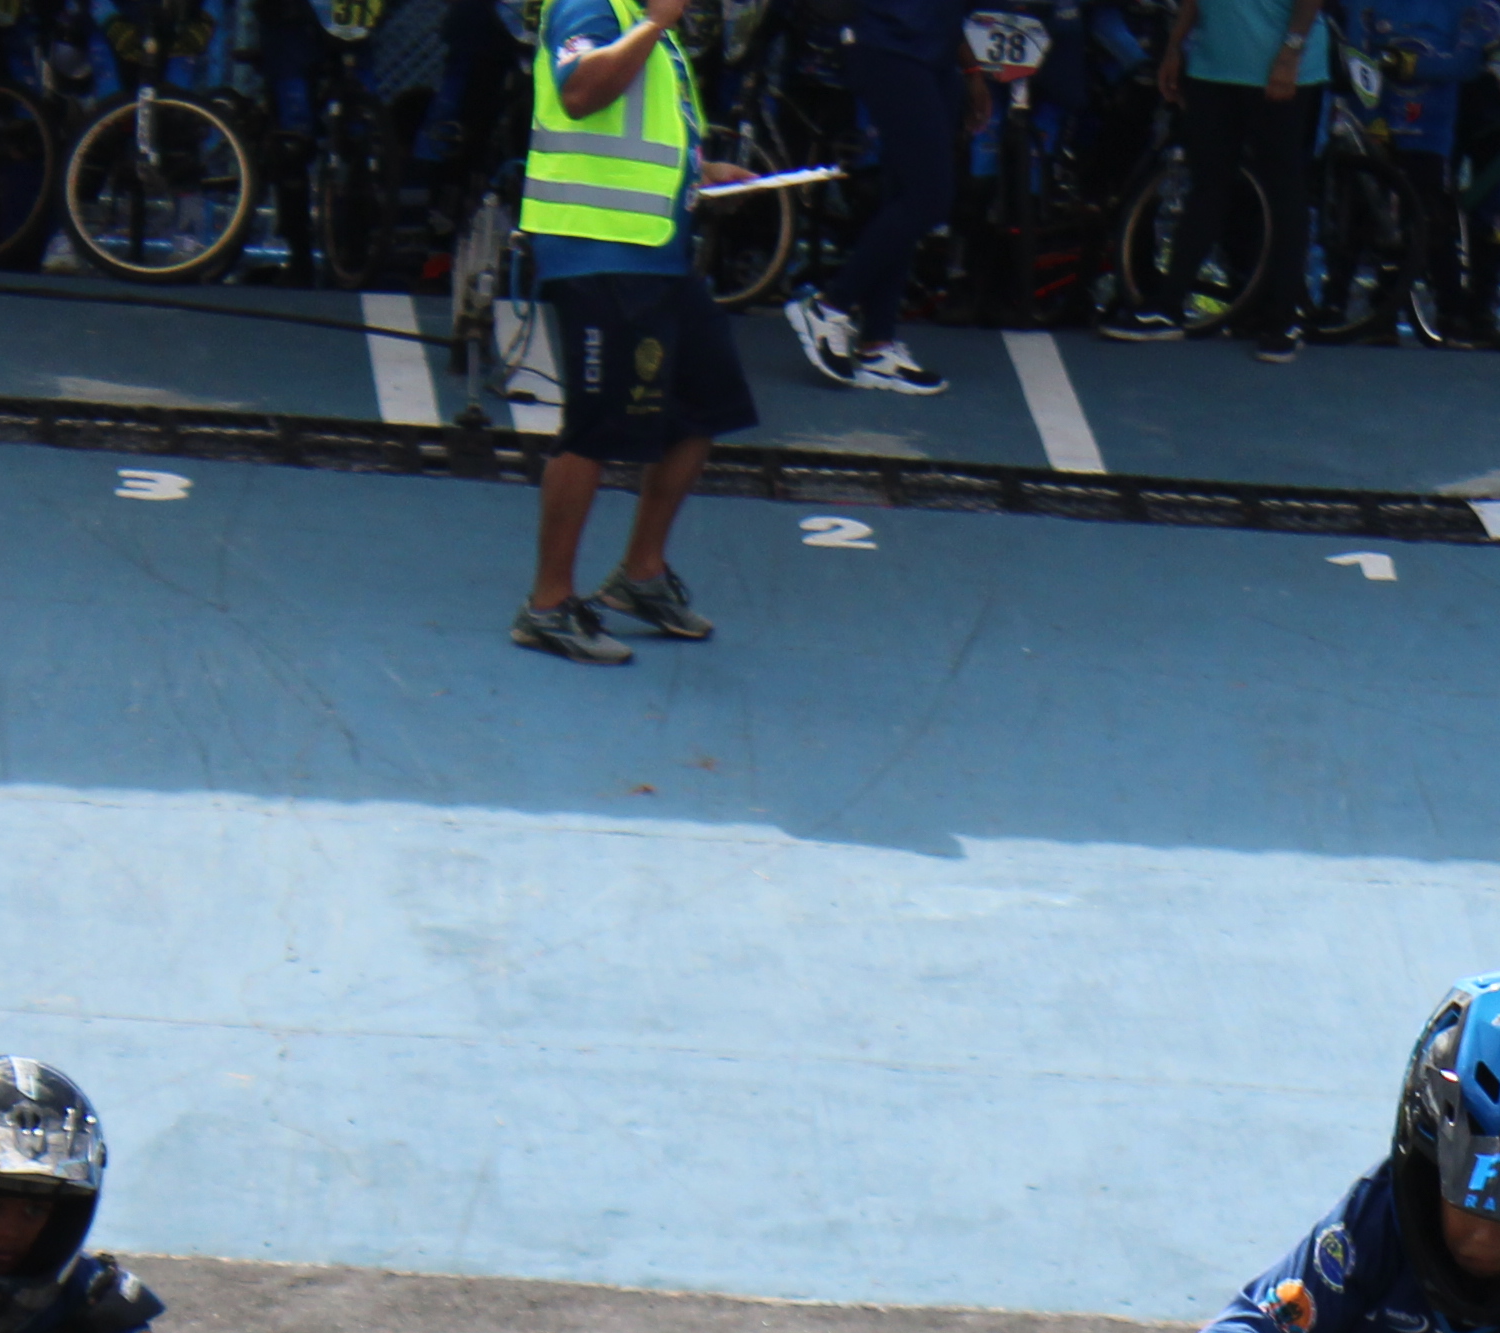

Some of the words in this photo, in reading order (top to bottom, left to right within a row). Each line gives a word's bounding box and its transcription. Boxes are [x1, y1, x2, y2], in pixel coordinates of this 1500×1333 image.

[987, 32, 1026, 63] 38
[114, 468, 194, 501] 3
[799, 515, 878, 551] 2
[1324, 552, 1398, 581] 1
